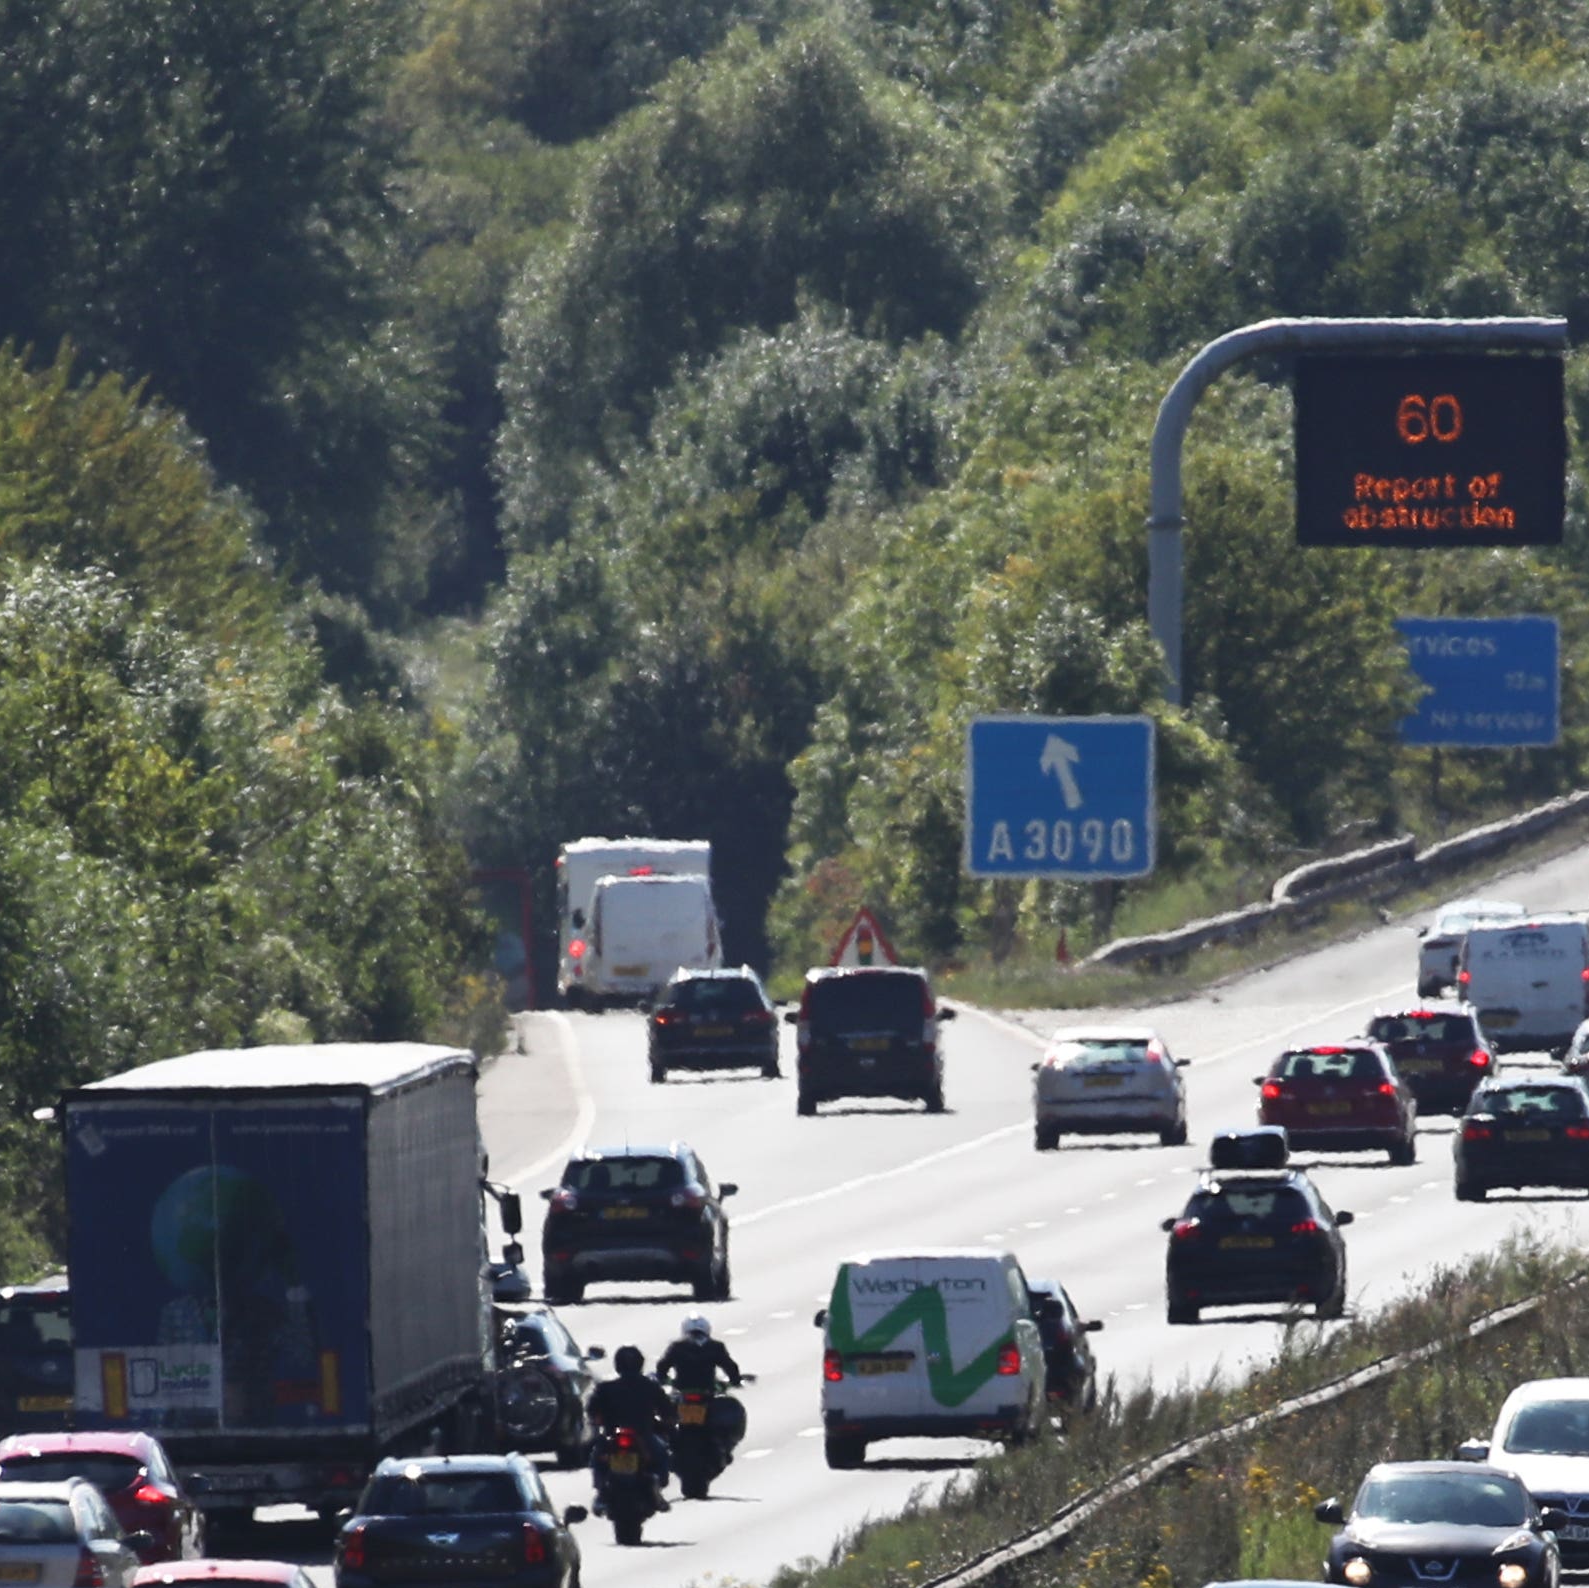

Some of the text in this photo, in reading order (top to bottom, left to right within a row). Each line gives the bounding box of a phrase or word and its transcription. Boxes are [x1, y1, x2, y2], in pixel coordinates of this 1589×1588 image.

[1397, 394, 1462, 443] 60
[1354, 472, 1503, 501] Report of
[1343, 501, 1516, 529] obstruction
